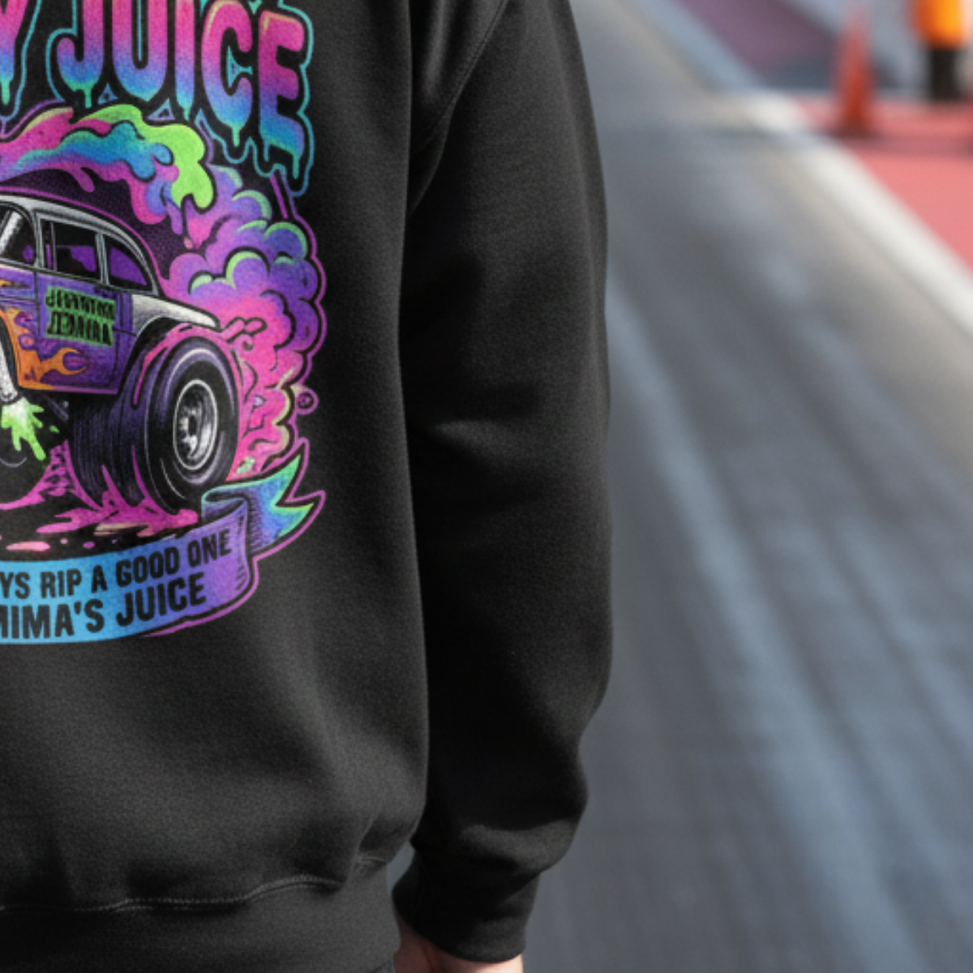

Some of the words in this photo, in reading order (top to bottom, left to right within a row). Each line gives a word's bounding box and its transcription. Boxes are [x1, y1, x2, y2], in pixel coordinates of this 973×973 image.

[40, 568, 82, 599] RIP
[90, 564, 108, 594] A
[115, 546, 180, 588] GOOD
[187, 529, 232, 568] ONE
[116, 572, 206, 627] JUICE
